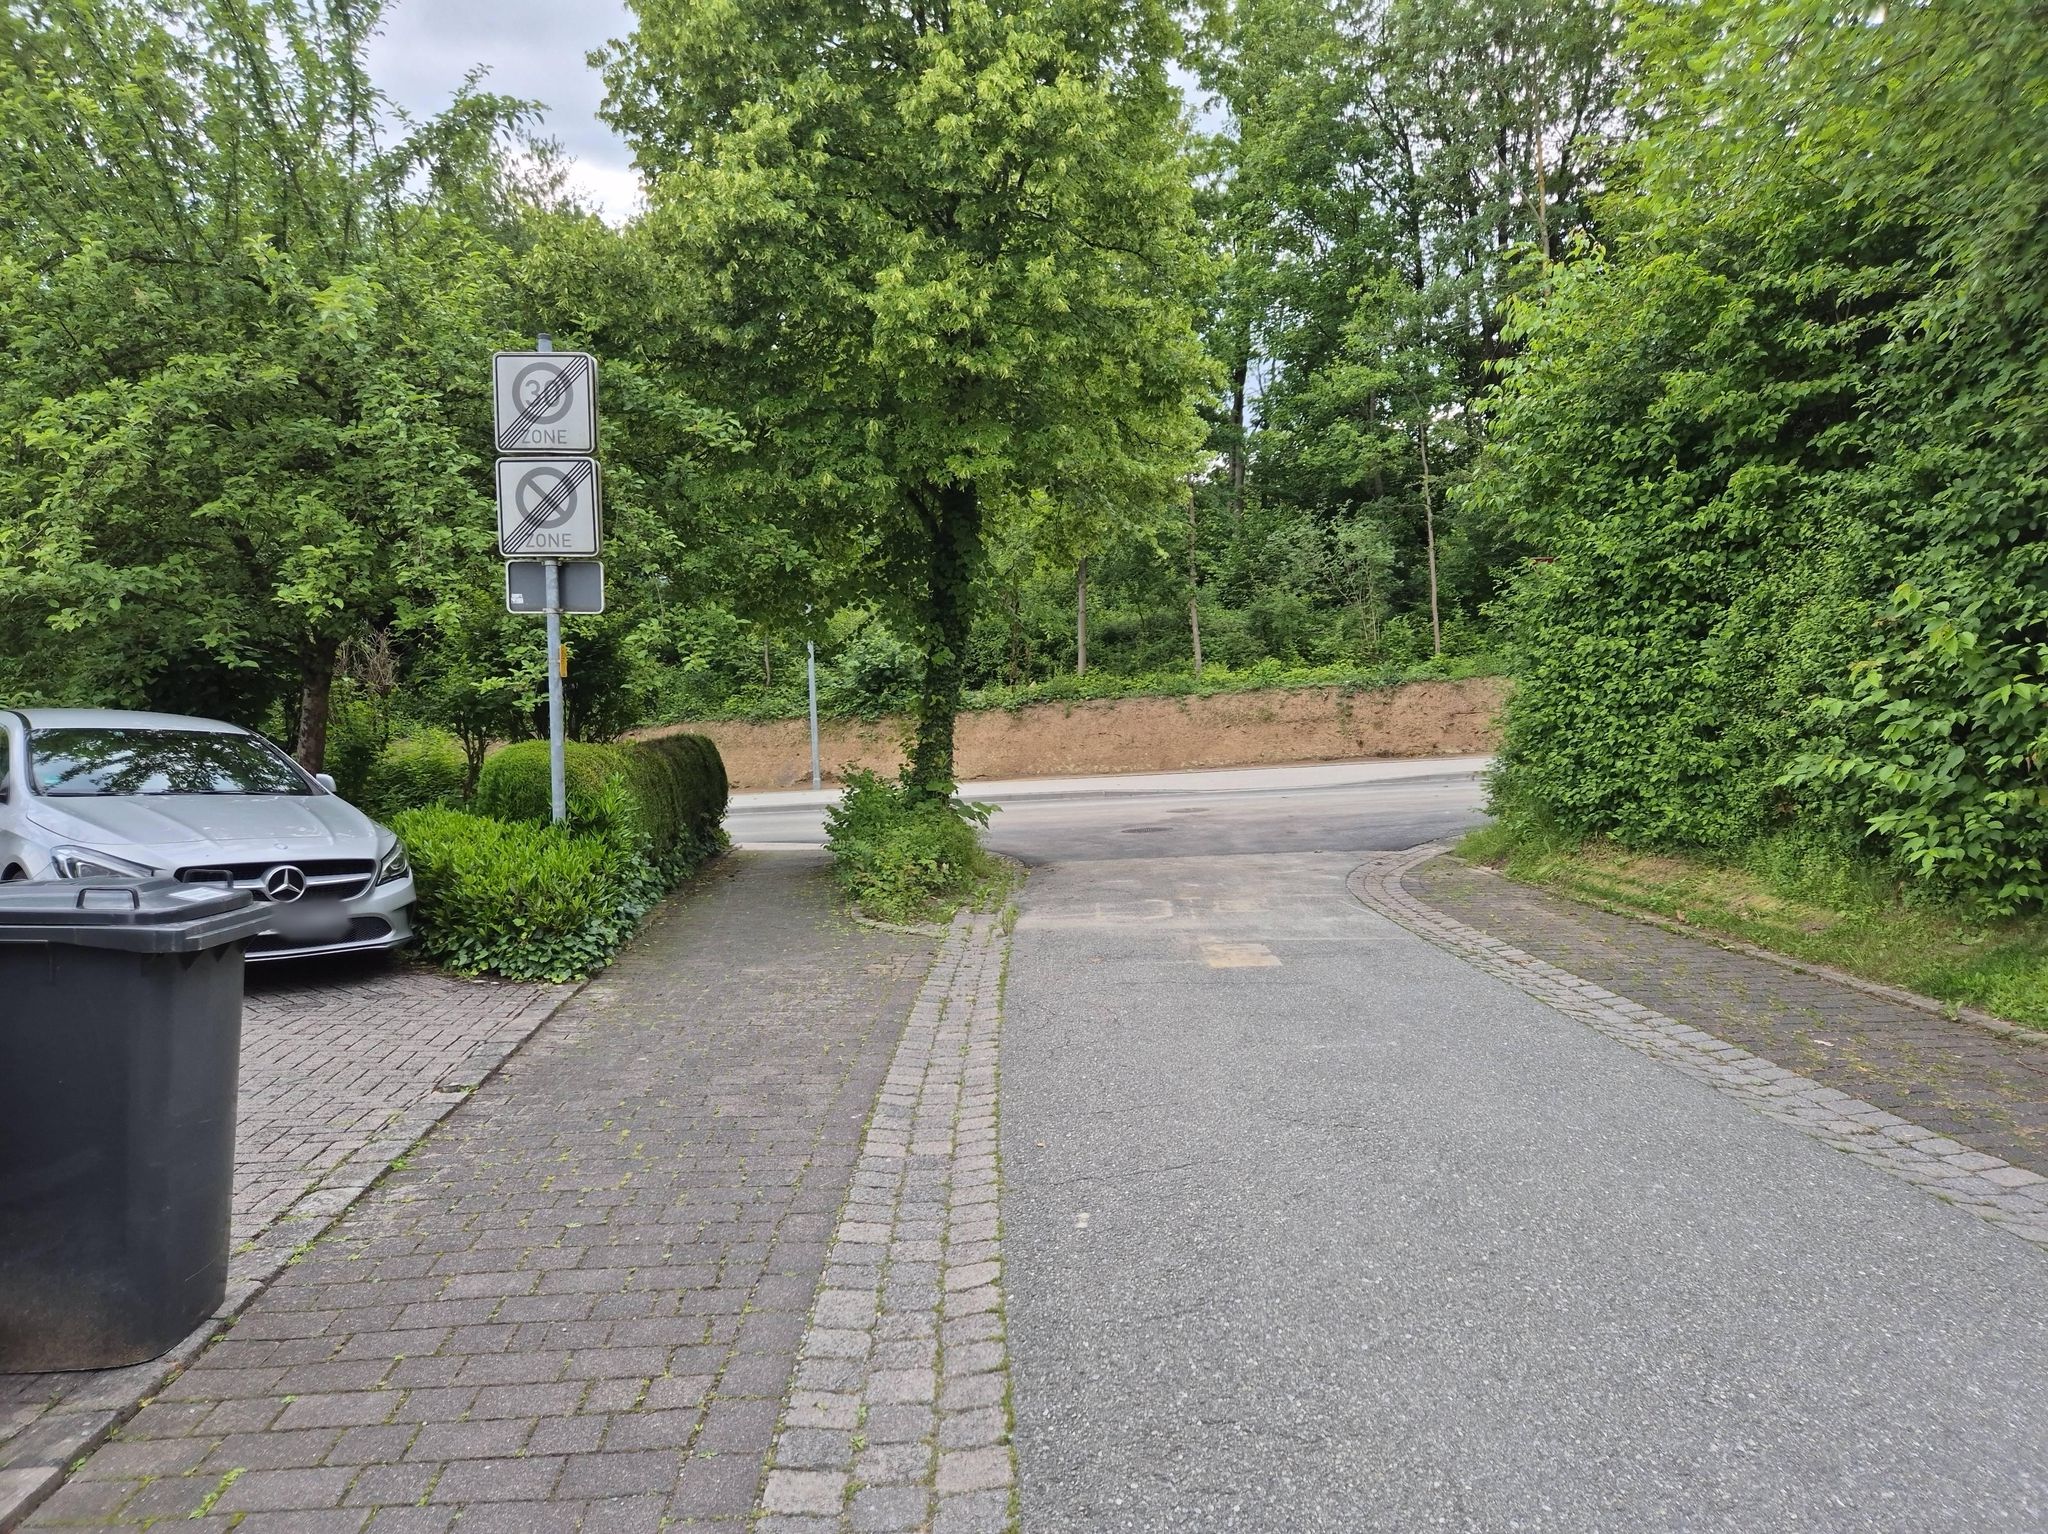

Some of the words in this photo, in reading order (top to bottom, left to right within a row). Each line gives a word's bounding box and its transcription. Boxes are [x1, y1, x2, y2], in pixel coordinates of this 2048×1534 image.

[525, 379, 560, 408] 30
[521, 429, 568, 445] ZONE
[525, 533, 572, 548] ZONE
